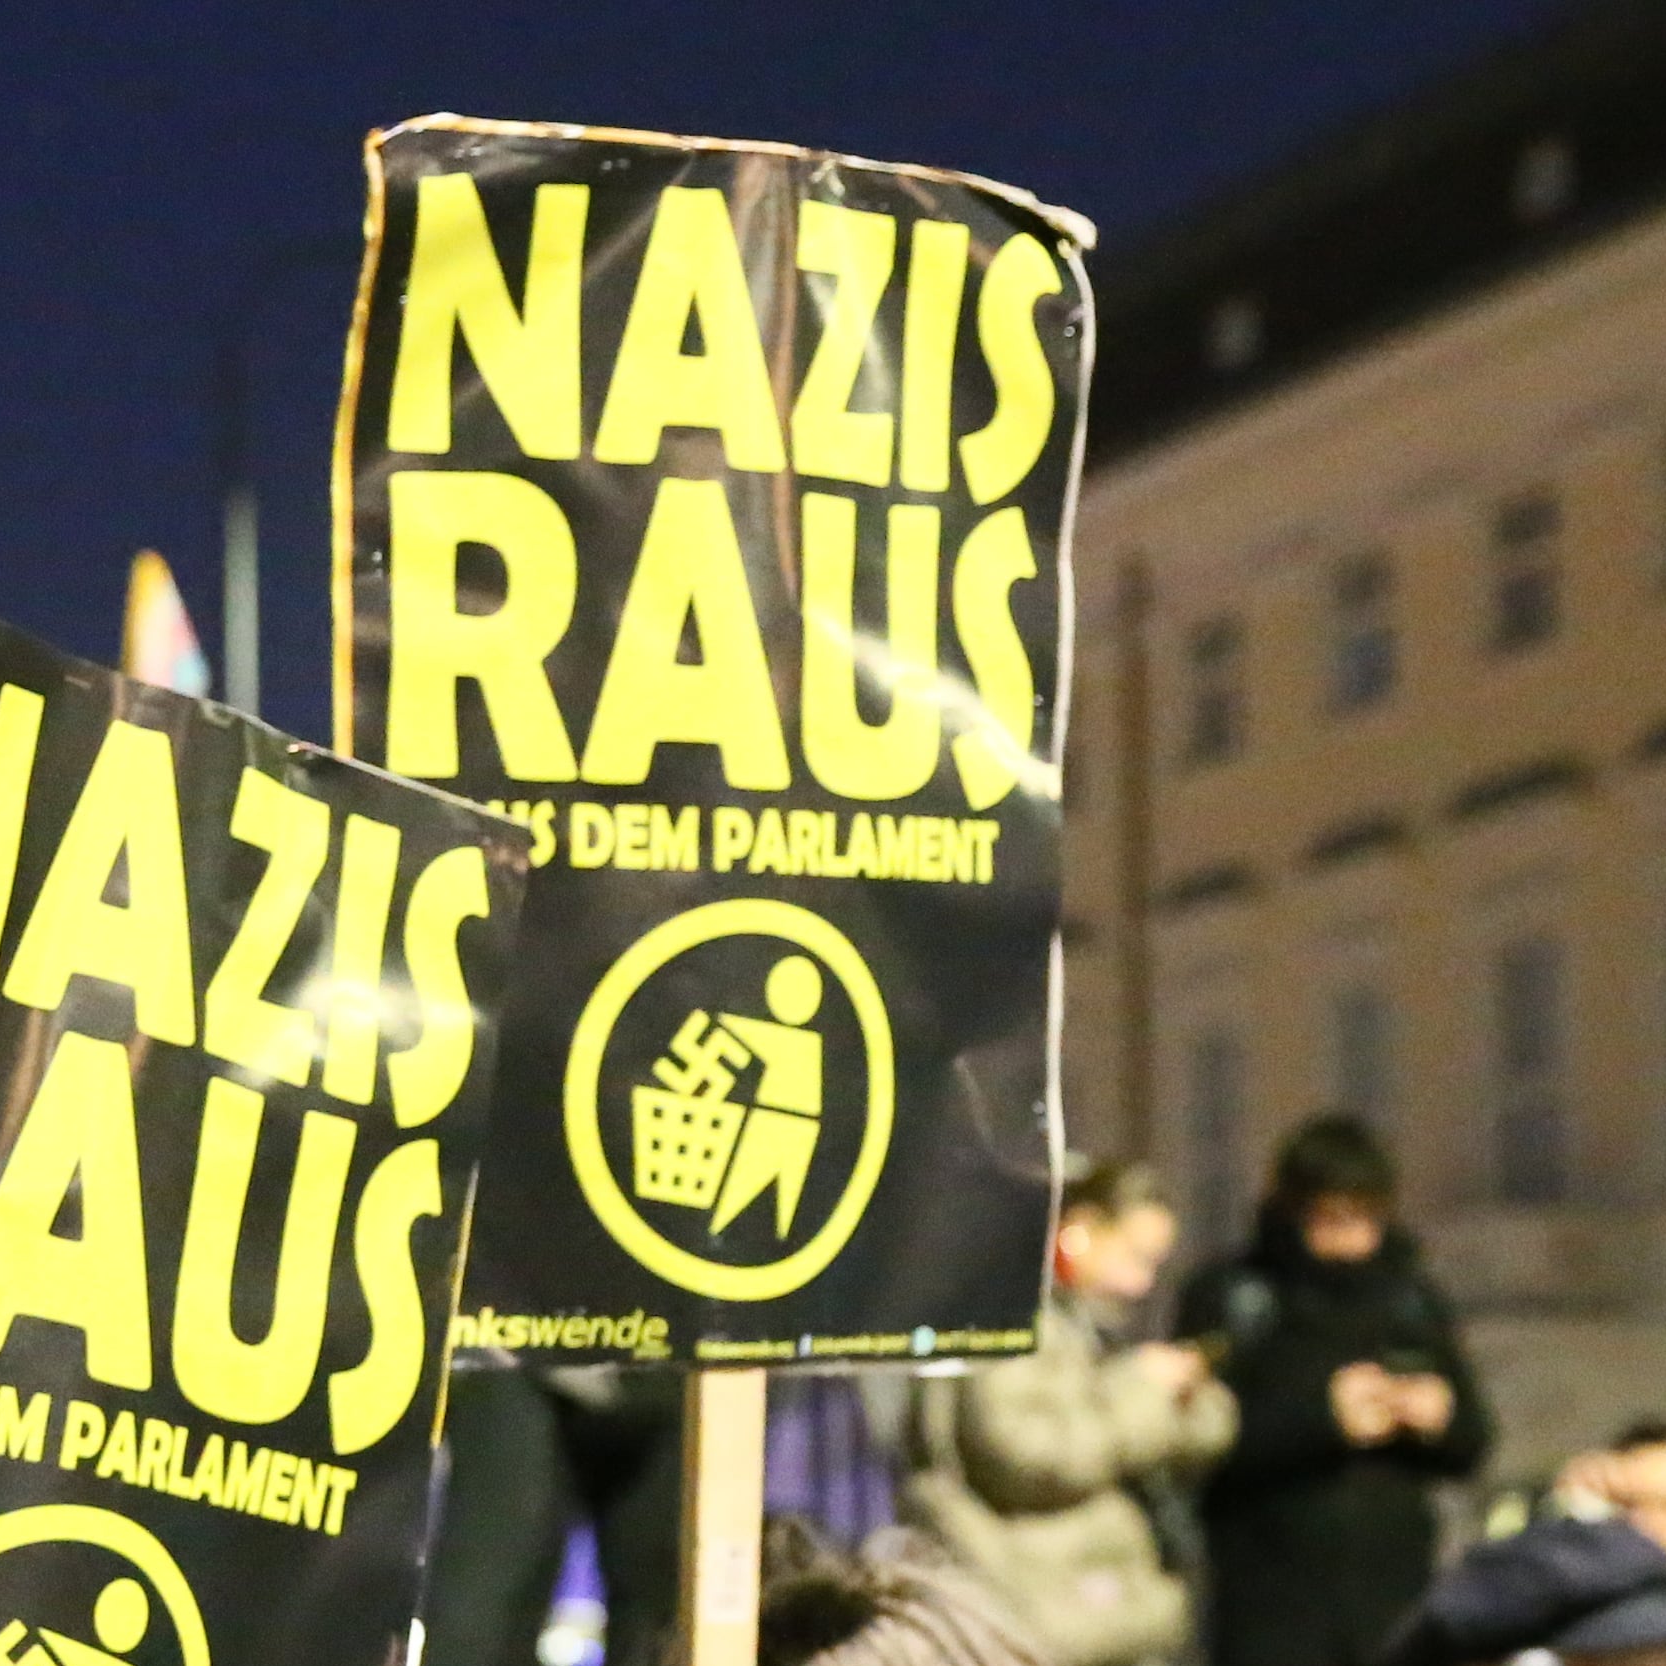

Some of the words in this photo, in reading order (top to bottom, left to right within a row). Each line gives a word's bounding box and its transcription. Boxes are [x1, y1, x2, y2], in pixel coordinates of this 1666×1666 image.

[387, 172, 1063, 506] NAZIS
[386, 471, 1039, 811] RAUS
[567, 801, 703, 873] DEM
[710, 805, 1002, 884] PARLAMENT
[450, 1305, 671, 1349] nkswende
[58, 1399, 359, 1537] PARLAMENT
